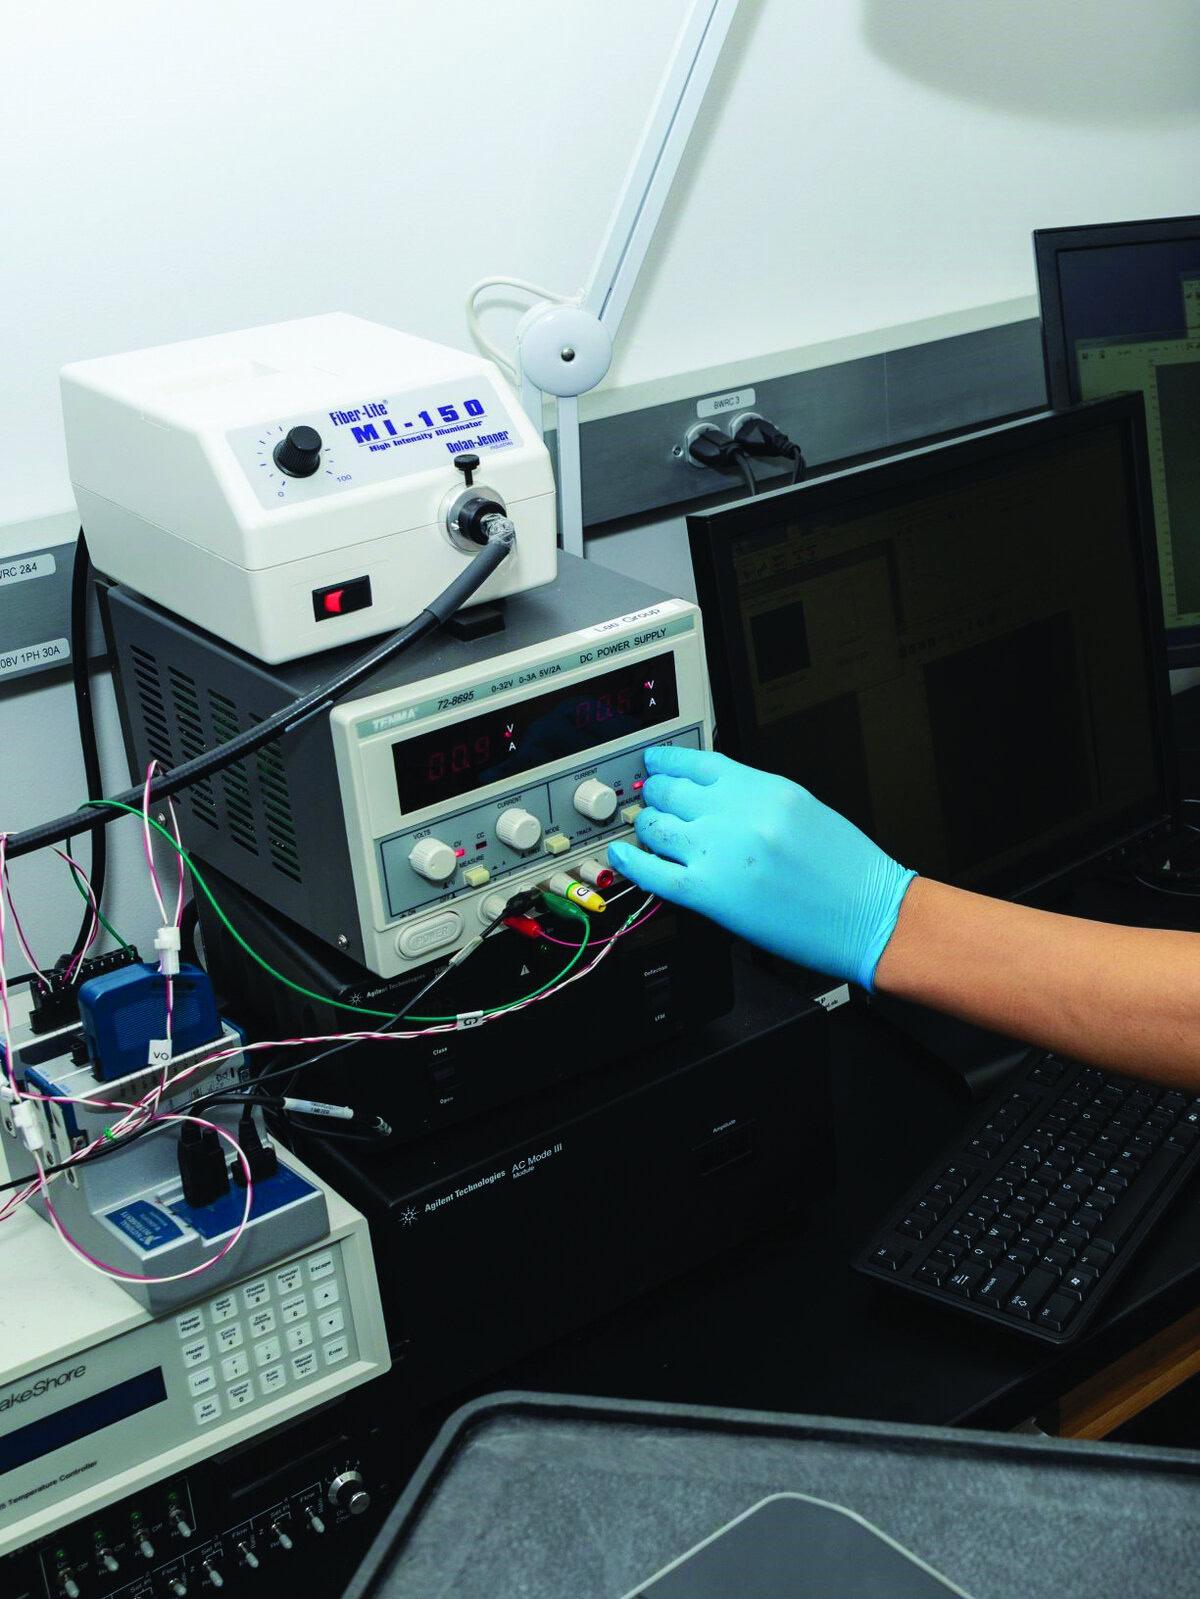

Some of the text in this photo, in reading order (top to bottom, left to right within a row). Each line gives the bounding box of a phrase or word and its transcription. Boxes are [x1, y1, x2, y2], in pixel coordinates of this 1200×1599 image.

[735, 396, 740, 404] 3
[369, 420, 483, 452] High Intensity Illuminator
[446, 430, 509, 454] Dolan-Jenner
[336, 474, 352, 484] 100
[20, 562, 38, 574] 2&4
[21, 650, 40, 664] 1PH
[42, 646, 60, 658] 30A
[438, 691, 474, 710] 72-8695
[492, 680, 514, 693] 0-32V
[518, 672, 536, 684] 0-3A
[539, 664, 562, 677] 5V/2A
[580, 653, 593, 664] DC
[597, 640, 630, 658] POWER
[634, 628, 667, 646] SUPPLY
[506, 723, 514, 733] V
[508, 741, 517, 752] A
[574, 768, 598, 780] CURRENT
[413, 829, 432, 840] VOLTS
[544, 826, 560, 835] MODE
[576, 827, 593, 836] TRACK
[459, 854, 484, 868] MEASURE
[424, 1193, 454, 1212] Agilent
[454, 1170, 506, 1198] Technologies
[512, 1160, 526, 1173] AC
[528, 1149, 552, 1166] Mode
[988, 1228, 999, 1236] W
[310, 1261, 331, 1272] Escape
[181, 1321, 200, 1332] Range
[329, 1347, 343, 1356] Enter
[194, 1377, 210, 1386] Loop
[8, 1461, 98, 1505] Temperature Controller
